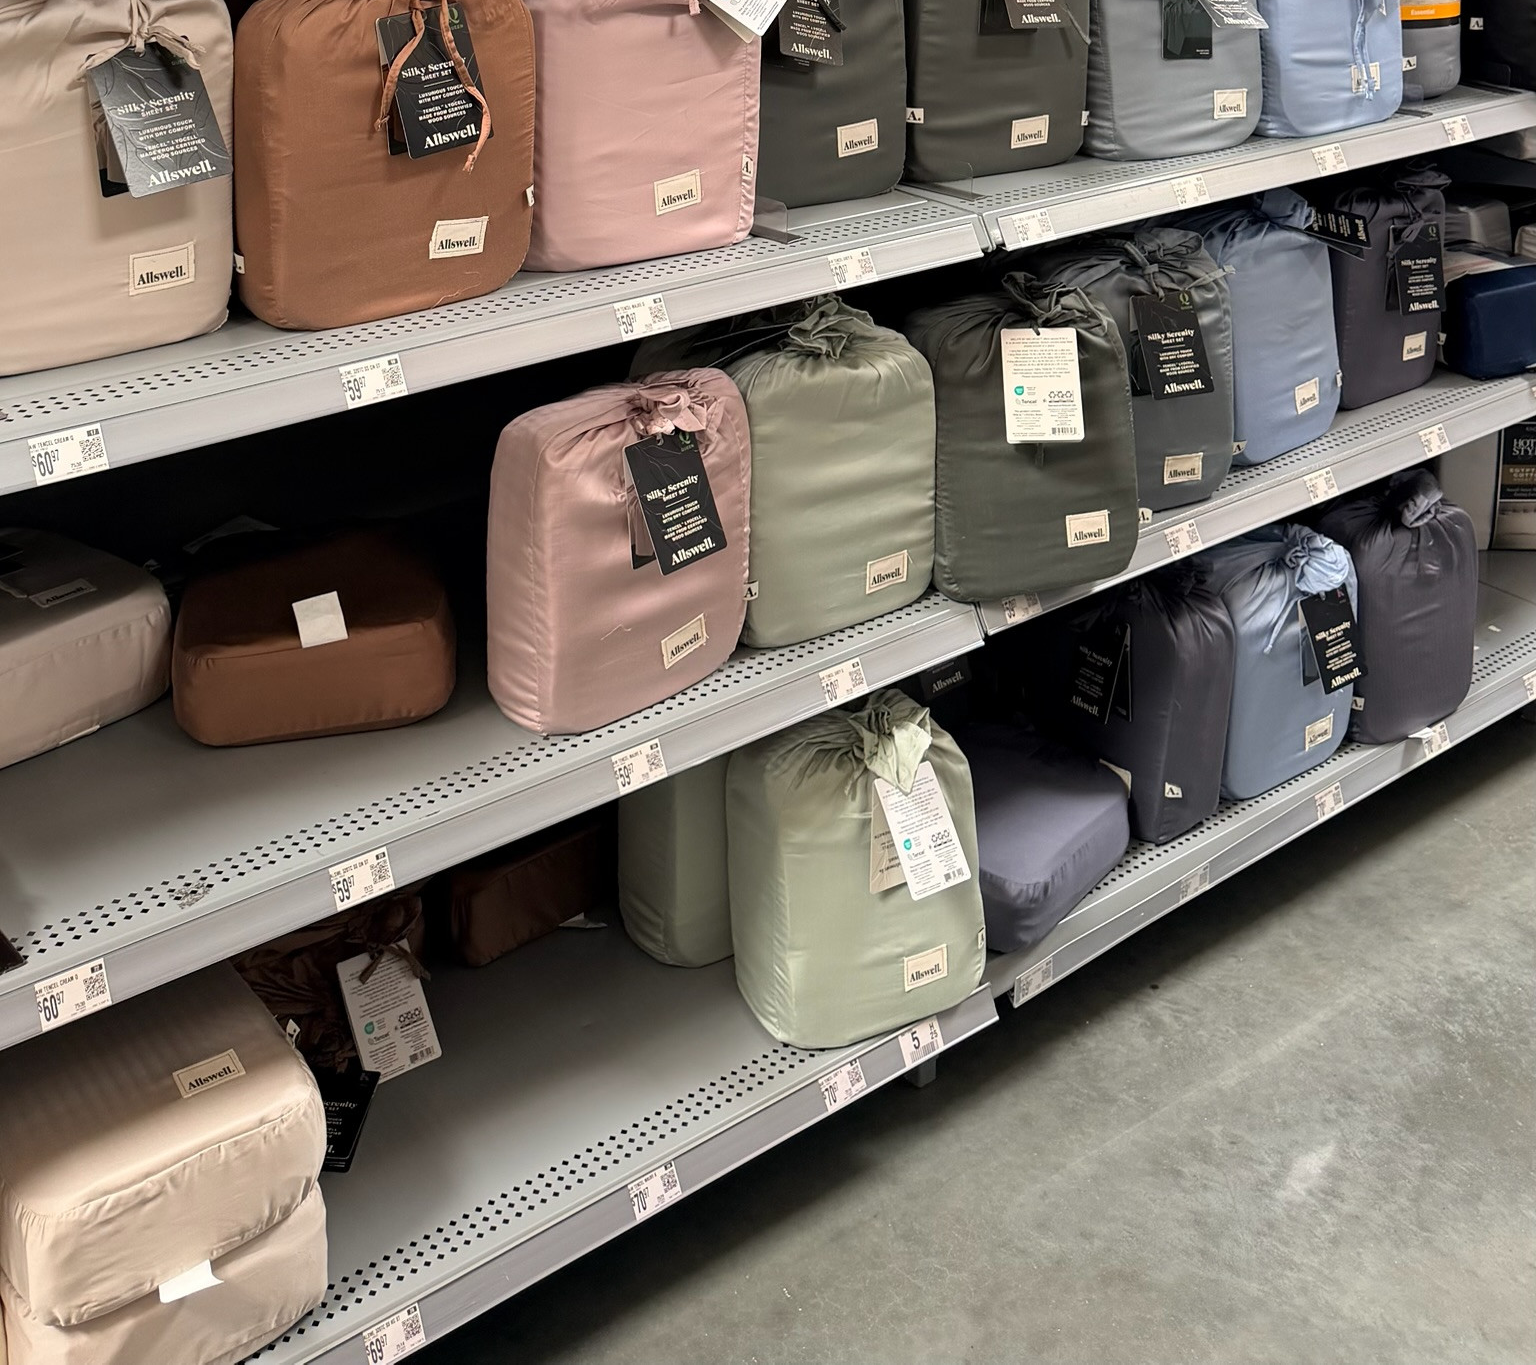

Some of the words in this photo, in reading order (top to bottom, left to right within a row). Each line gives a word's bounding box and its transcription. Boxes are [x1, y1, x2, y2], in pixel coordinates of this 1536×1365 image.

[1021, 14, 1061, 24] Allswell.
[791, 42, 833, 60] Allswell.
[401, 65, 427, 79] Silky
[1404, 59, 1416, 69] A.
[421, 72, 441, 82] SHEET
[441, 69, 452, 77] SET
[117, 101, 148, 116] Silky
[148, 90, 196, 110] Serenity
[140, 107, 164, 118] SHEET
[164, 103, 179, 113] SET
[906, 110, 922, 122] A.
[138, 122, 173, 136] LUXURIOUS
[172, 118, 193, 128] TOUCH
[167, 123, 196, 136] COMFORT
[423, 123, 480, 150] Allswell.
[843, 135, 875, 151] Allswell.
[1015, 129, 1044, 143] Allswell.
[148, 158, 217, 189] Allswell.
[742, 160, 752, 175] A.
[661, 188, 696, 208] Allswell.
[436, 236, 478, 251] Allswell.
[136, 265, 187, 287] Allswell.
[1408, 299, 1440, 313] Allswell.
[1166, 328, 1195, 339] Serenity
[1163, 378, 1206, 395] Allswell.
[1167, 467, 1198, 479] Allswell.
[646, 488, 667, 502] Silky
[667, 474, 699, 493] Serenity
[1073, 527, 1106, 543] Allswell.
[671, 536, 716, 567] Allswell.
[871, 566, 902, 586] Allswell.
[744, 585, 757, 599] A.
[669, 630, 702, 660] Allswell.
[1330, 666, 1362, 690] Allswell.
[1069, 694, 1100, 718] Allswell.
[1166, 786, 1180, 796] A.
[909, 963, 943, 983] Allswell.
[911, 1030, 921, 1050] 5
[186, 1064, 237, 1091] Allswell.
